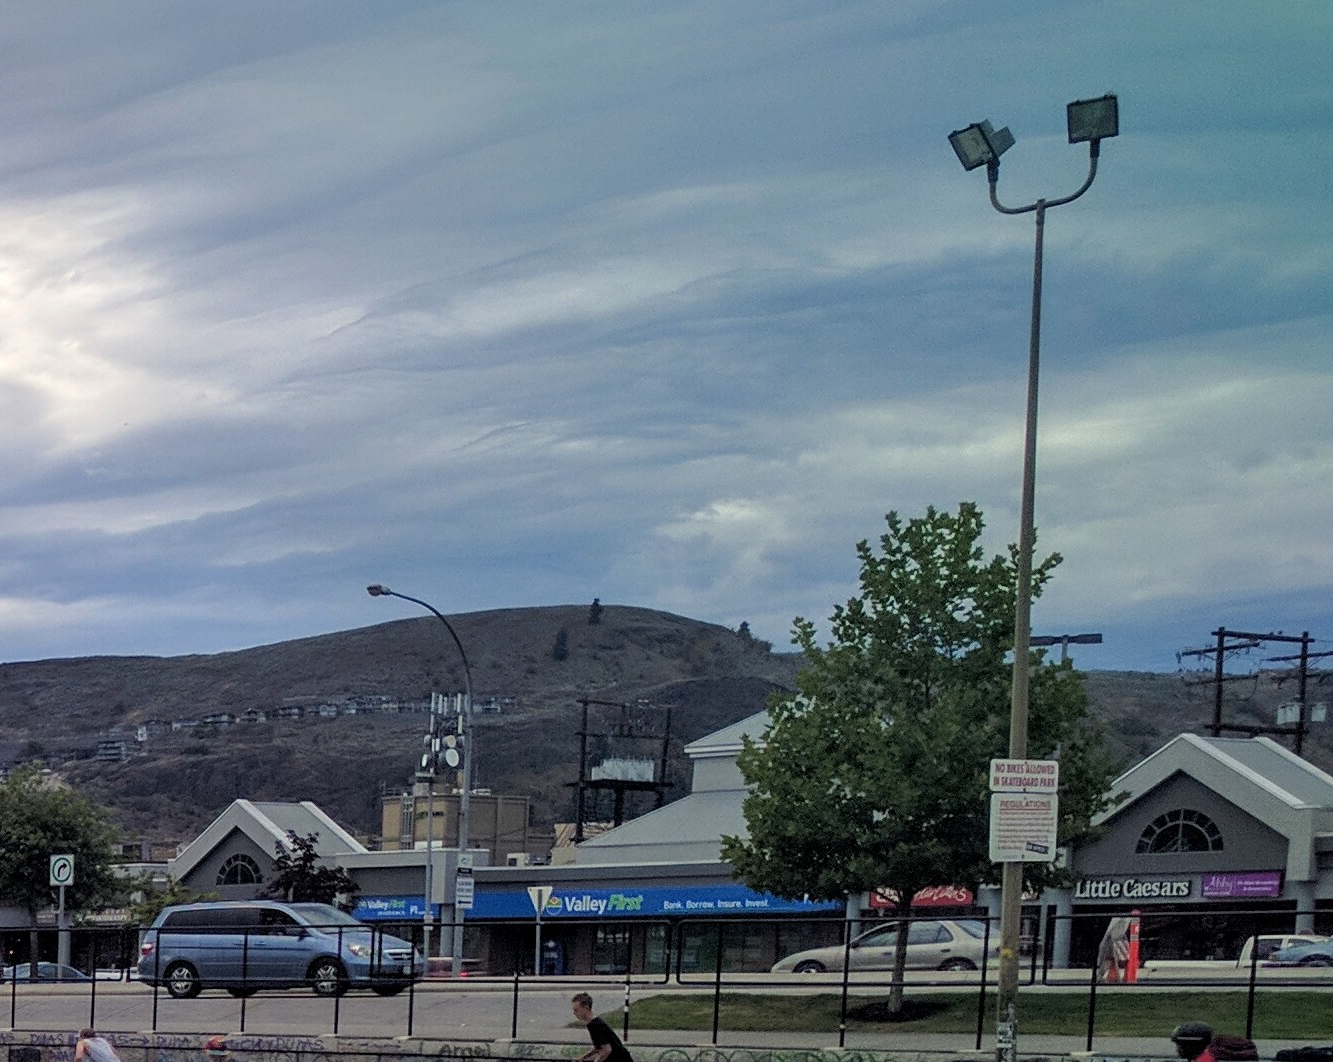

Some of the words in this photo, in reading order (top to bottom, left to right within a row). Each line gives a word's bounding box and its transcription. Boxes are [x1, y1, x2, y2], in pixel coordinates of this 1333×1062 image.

[995, 763, 1005, 772] NO
[1007, 764, 1024, 773] BIKES
[1025, 764, 1055, 774] ALLOWED
[993, 776, 1000, 785] IN
[1001, 776, 1038, 786] SKATEBOARD
[1040, 777, 1055, 787] PARK
[1074, 880, 1121, 898] Little
[1123, 879, 1190, 898] Caesars
[366, 900, 389, 910] Valley
[564, 895, 607, 915] Valley
[607, 894, 644, 911] First
